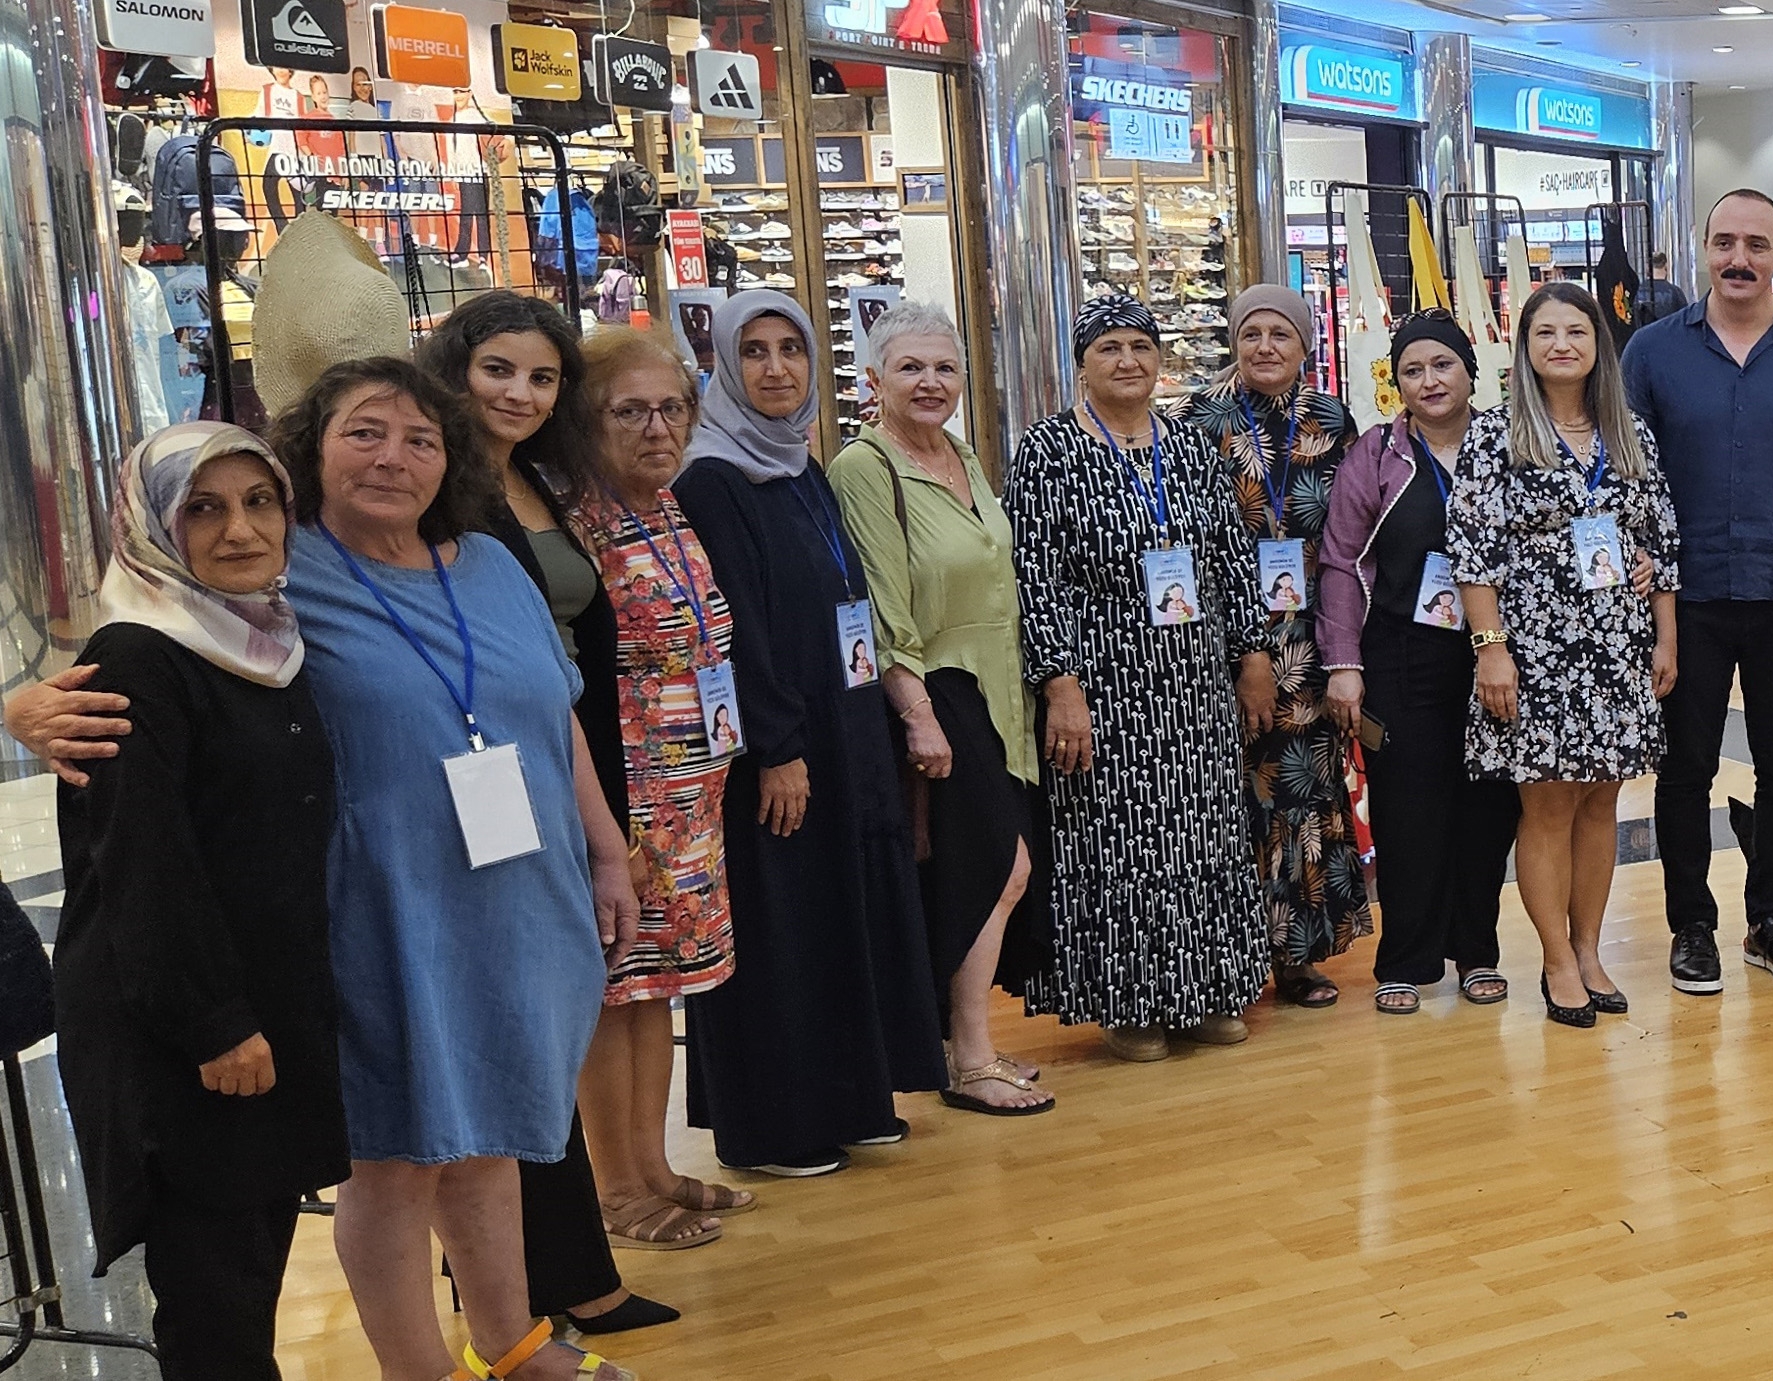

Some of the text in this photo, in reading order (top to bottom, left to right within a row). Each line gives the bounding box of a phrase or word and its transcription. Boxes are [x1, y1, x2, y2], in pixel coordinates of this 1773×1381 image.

[115, 0, 205, 22] SALOMON
[388, 35, 465, 59] MERRELL
[530, 49, 552, 63] Jack
[530, 61, 573, 78] Wolfskin
[1317, 58, 1393, 97] watsons
[1081, 75, 1193, 113] SKECHERS
[1544, 97, 1594, 128] watsons
[703, 147, 737, 175] NS
[815, 146, 844, 173] NS
[322, 190, 455, 211] SKECHERS
